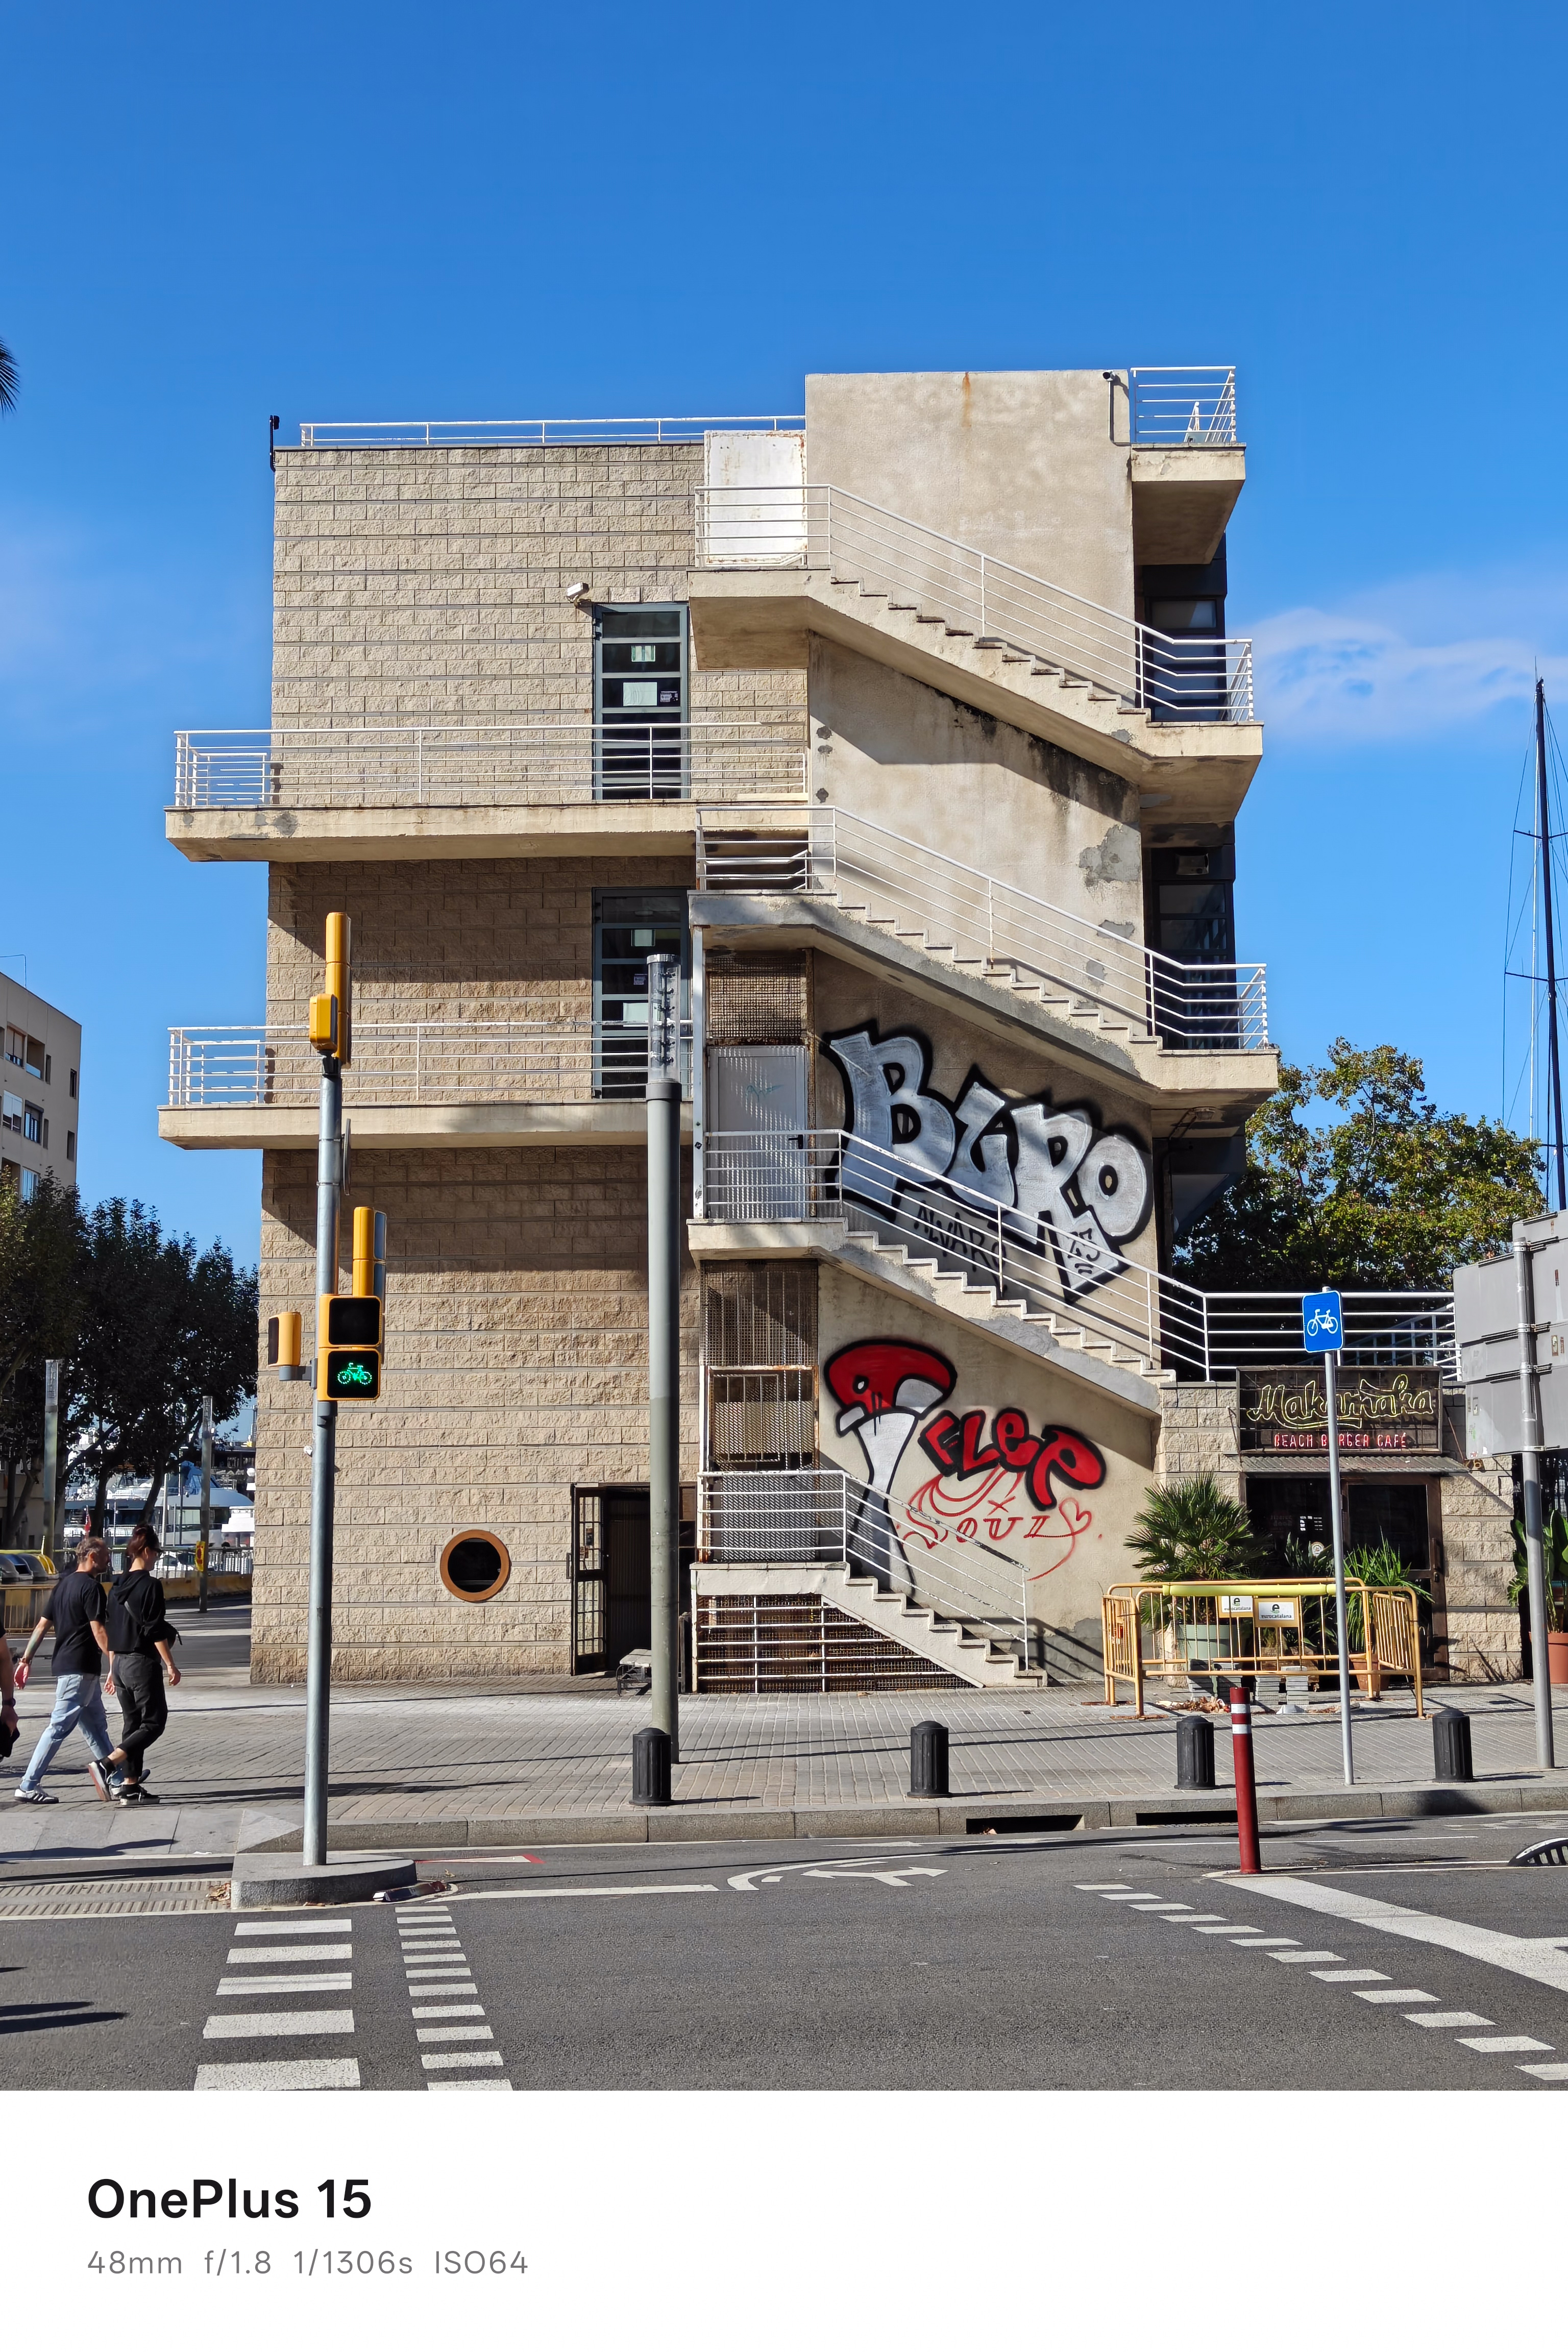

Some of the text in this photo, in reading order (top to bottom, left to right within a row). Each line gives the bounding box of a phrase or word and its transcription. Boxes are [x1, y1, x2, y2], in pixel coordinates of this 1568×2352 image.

[1246, 1374, 1434, 1429] Makmaka
[1274, 1429, 1407, 1448] BEACH BRGER CAFÉ
